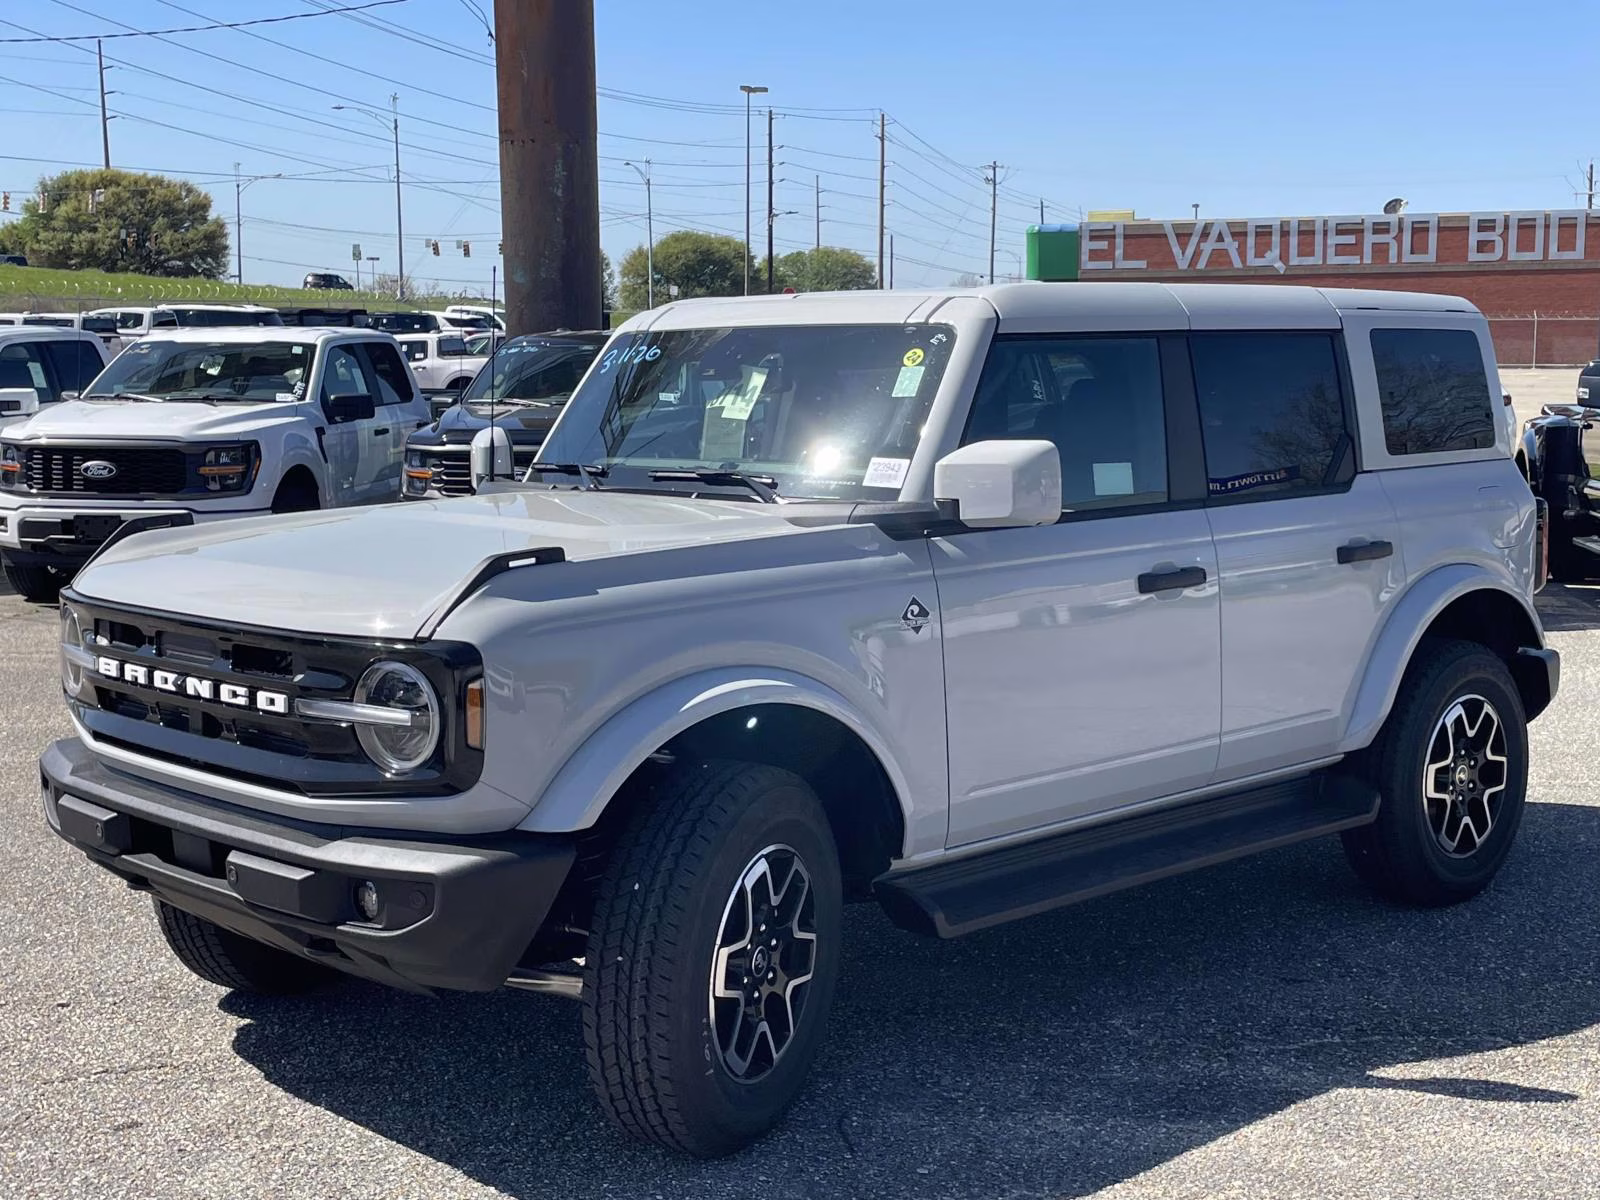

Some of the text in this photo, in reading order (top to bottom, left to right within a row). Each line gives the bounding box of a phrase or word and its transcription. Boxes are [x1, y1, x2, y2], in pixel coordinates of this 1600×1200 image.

[1080, 208, 1600, 274] EL VAQUERO BOO
[98, 656, 289, 714] BRONCO
